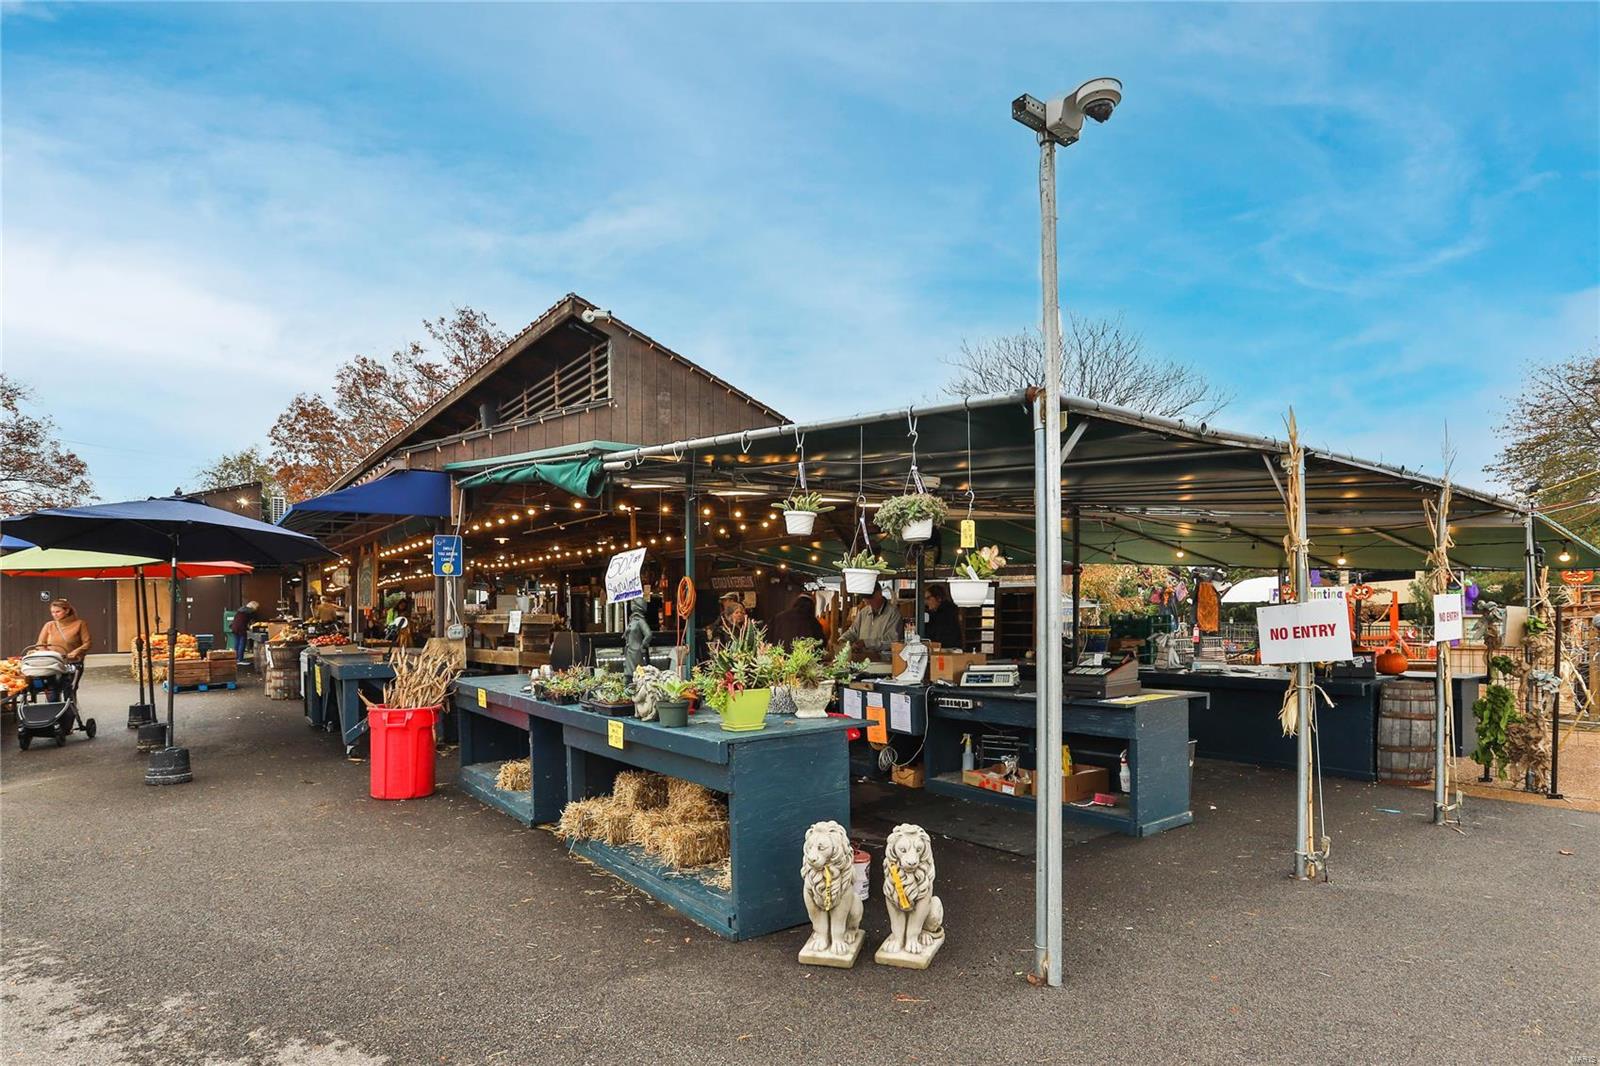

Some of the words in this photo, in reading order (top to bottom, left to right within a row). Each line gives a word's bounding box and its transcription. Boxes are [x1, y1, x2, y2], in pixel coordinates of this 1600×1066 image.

[1439, 612, 1445, 622] NO
[1446, 611, 1459, 622] ENTRY
[1270, 627, 1288, 640] NO
[1292, 623, 1336, 639] ENTRY
